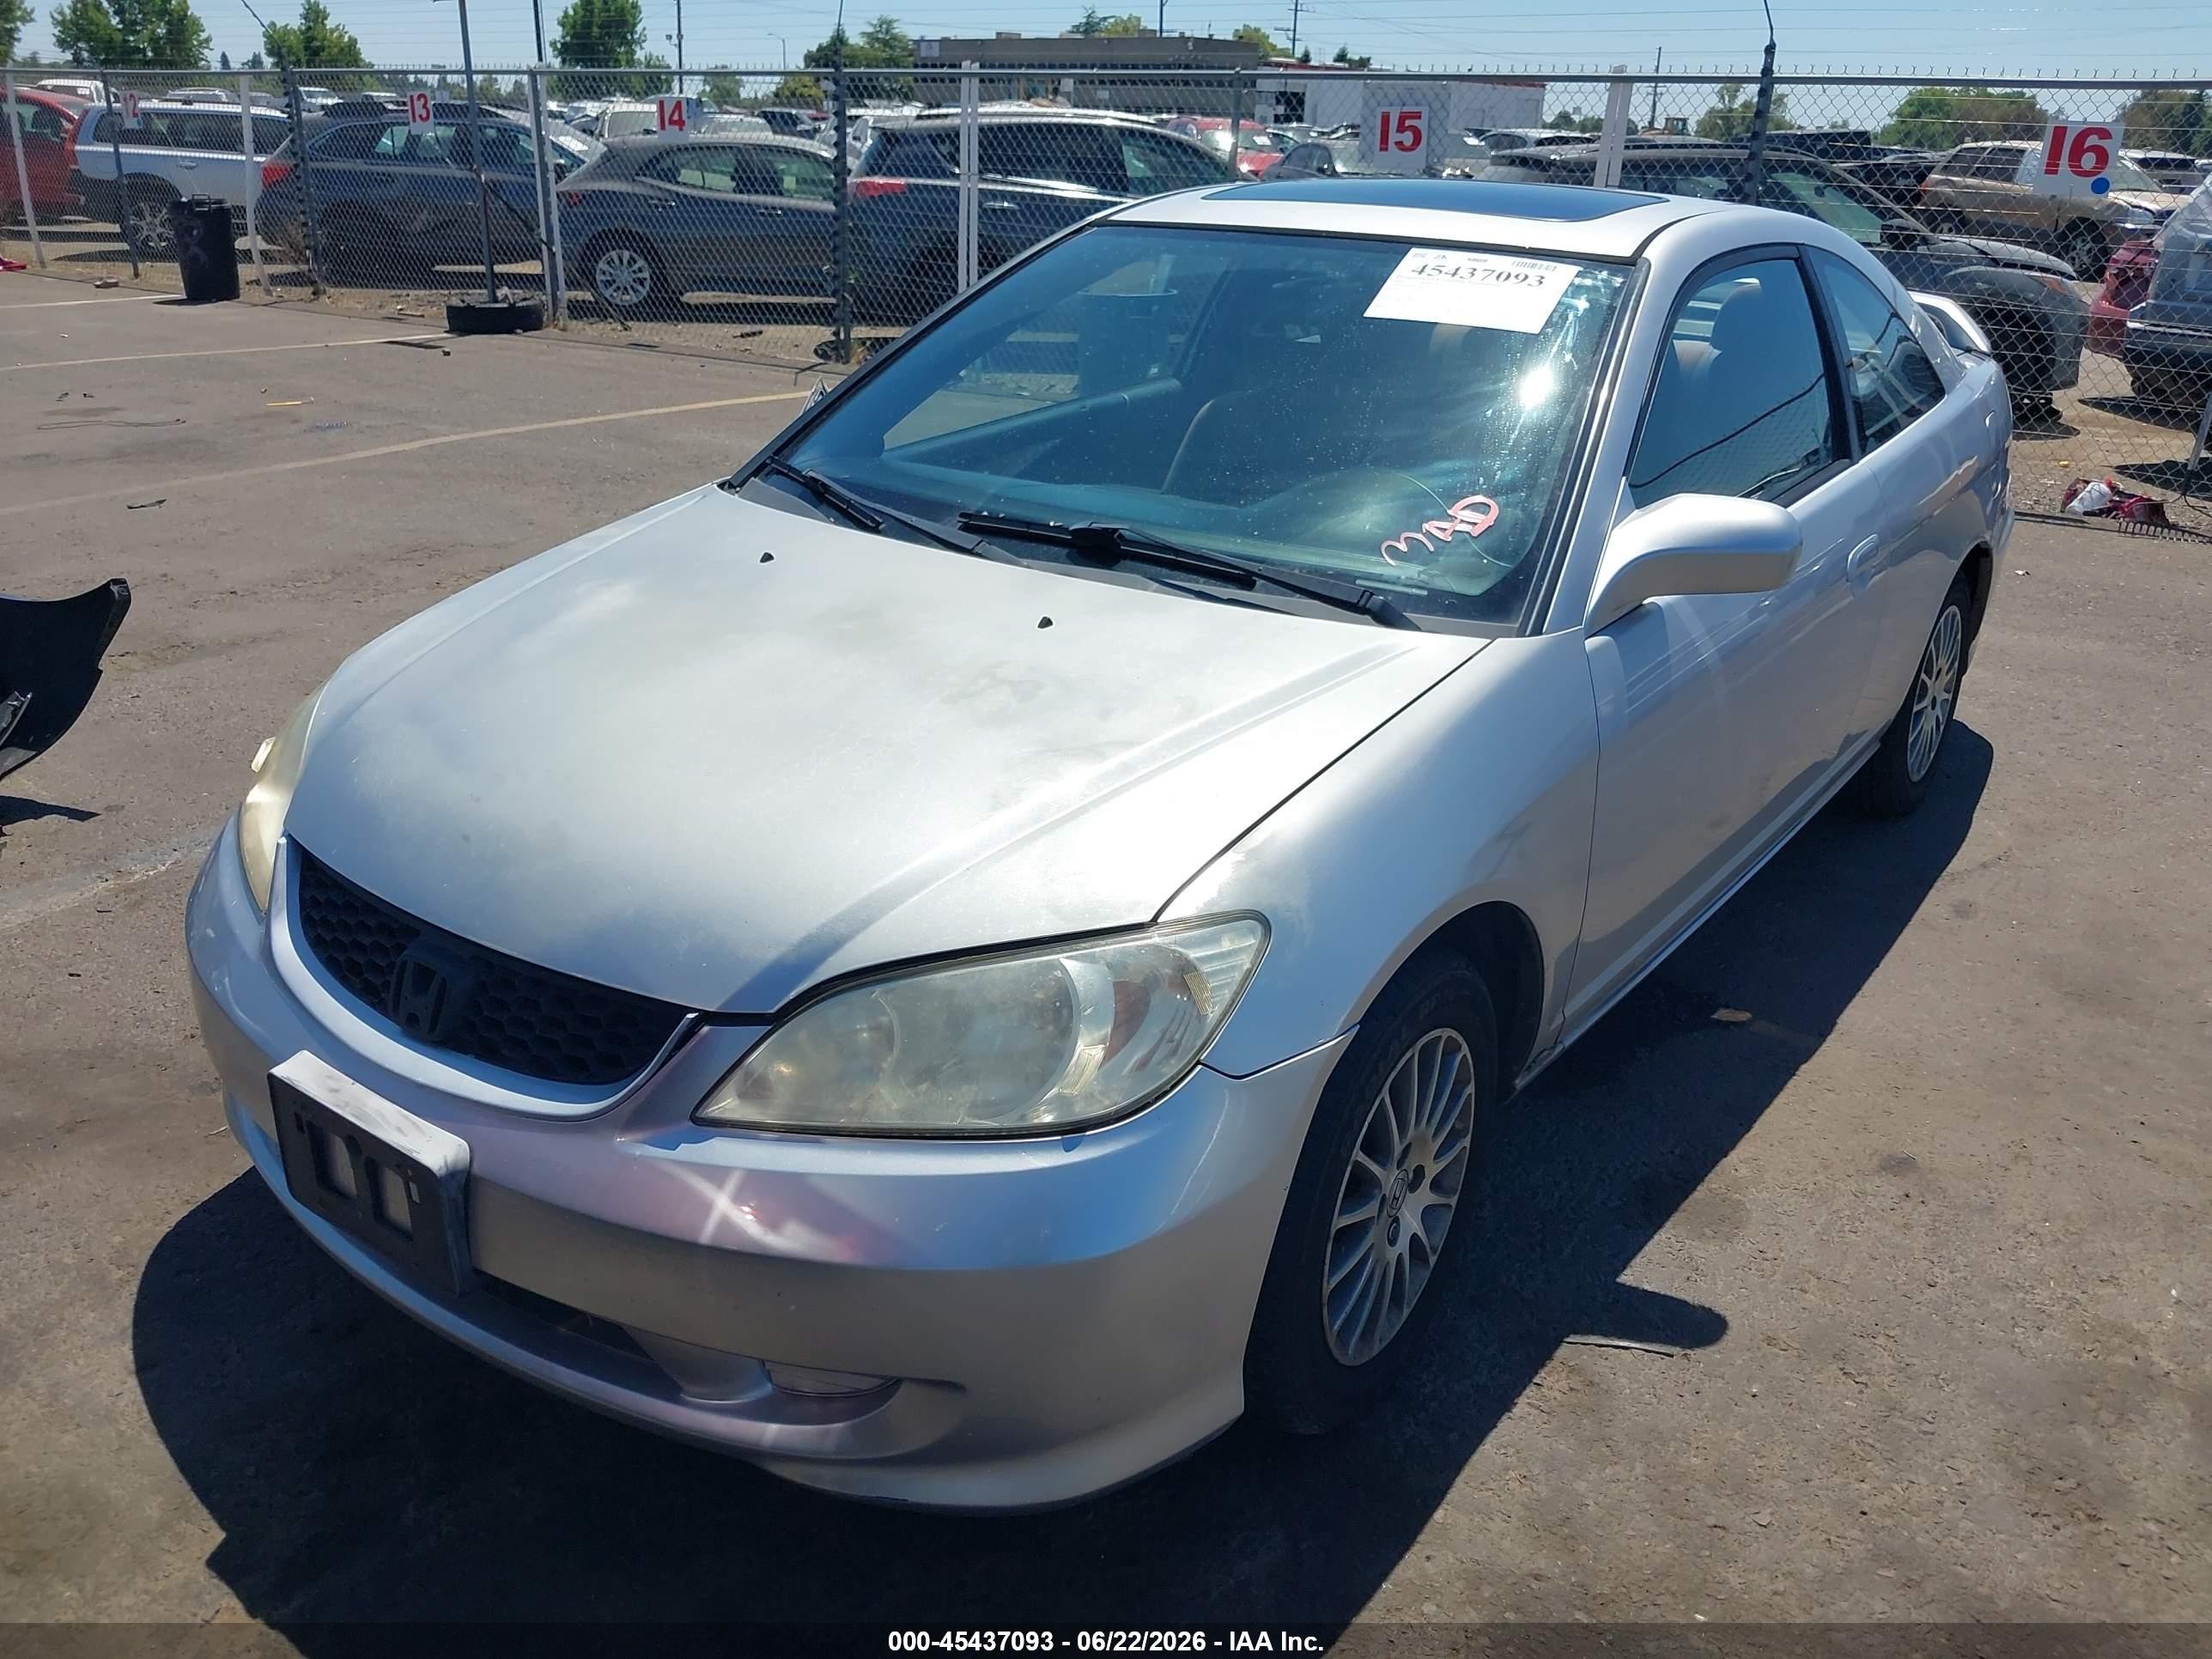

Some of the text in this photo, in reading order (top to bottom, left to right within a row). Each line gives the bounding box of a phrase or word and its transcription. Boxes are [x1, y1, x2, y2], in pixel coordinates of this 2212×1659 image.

[409, 93, 430, 123] 13
[659, 100, 685, 131] 14
[1379, 111, 1422, 152] 15
[2044, 125, 2112, 178] 16
[1411, 264, 1546, 288] 45437093
